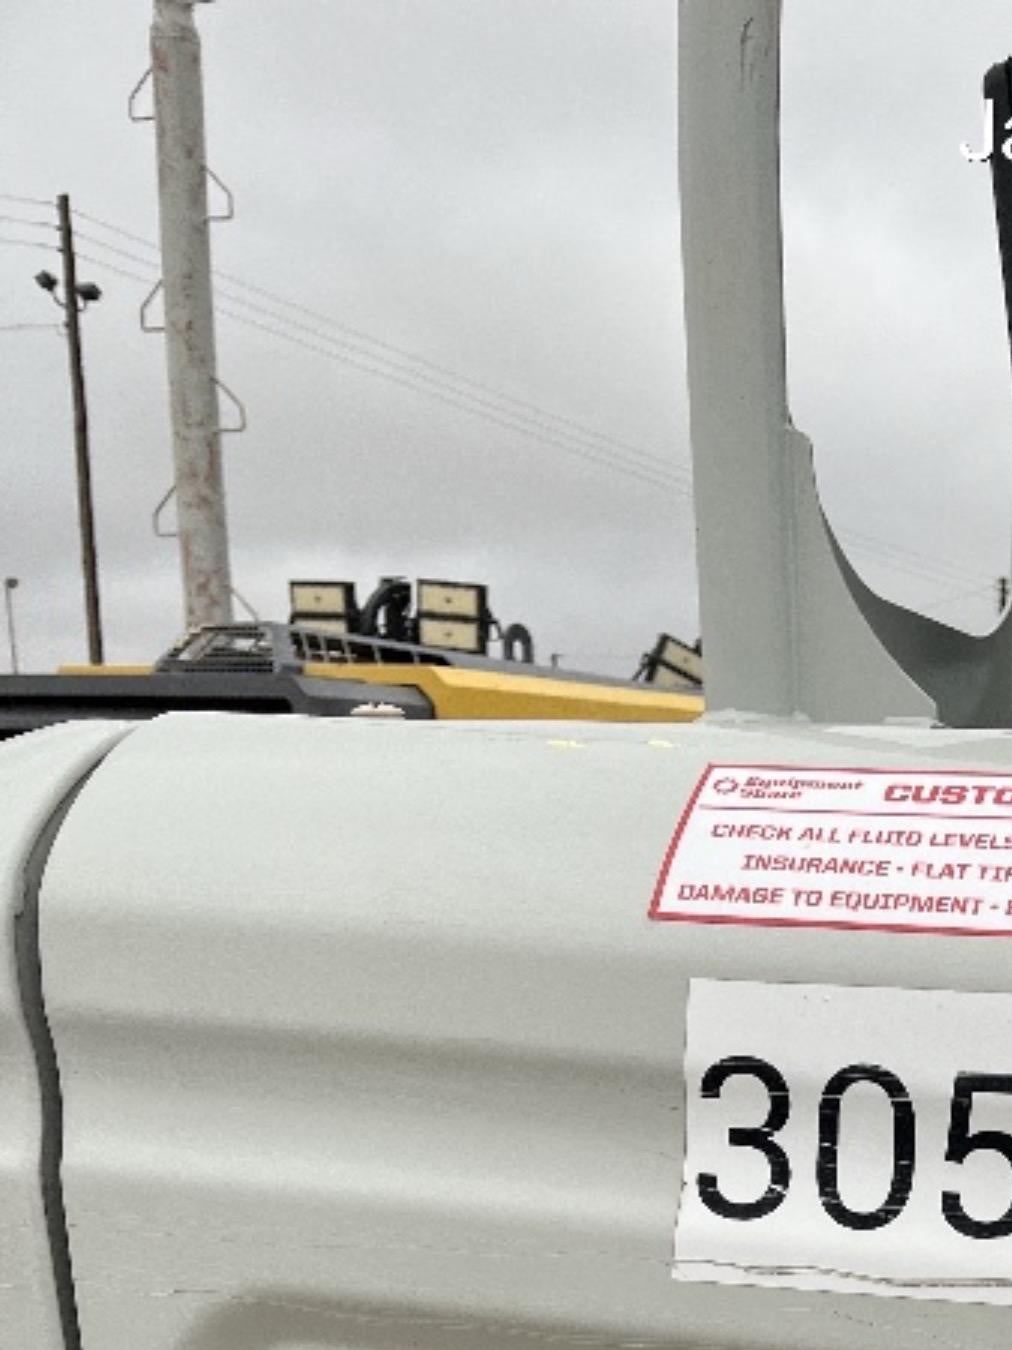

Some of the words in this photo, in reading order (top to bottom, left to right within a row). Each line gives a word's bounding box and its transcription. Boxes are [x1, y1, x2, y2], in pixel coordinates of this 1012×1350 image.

[711, 823, 791, 841] CHECK
[798, 827, 841, 844] ALL
[848, 828, 922, 847] FLUID
[741, 855, 891, 876] INSURANCE
[911, 862, 972, 881] FLAT
[677, 884, 785, 904] DAMAGE
[792, 889, 823, 906] TO
[829, 890, 985, 916] EQUIPMENT
